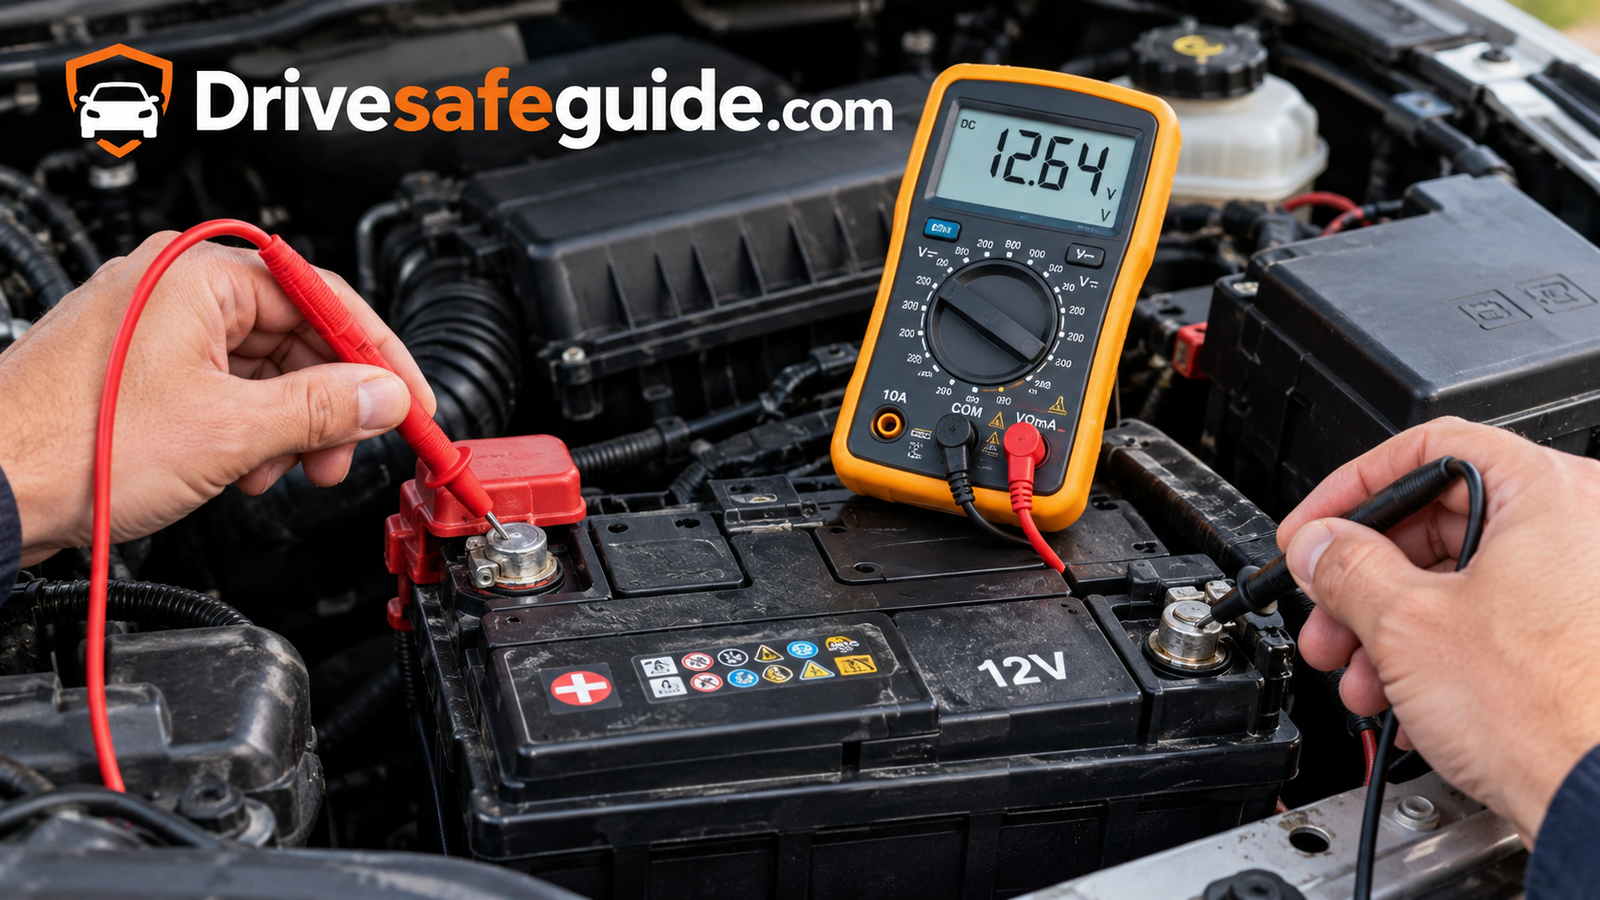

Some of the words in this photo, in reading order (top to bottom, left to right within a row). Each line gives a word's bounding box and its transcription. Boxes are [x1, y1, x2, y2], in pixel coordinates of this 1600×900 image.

[960, 119, 976, 130] DC
[990, 128, 1110, 197] 12.64
[1106, 187, 1117, 200] V
[1101, 208, 1111, 222] V
[1069, 305, 1085, 316] 200
[898, 328, 915, 338] 200
[1066, 331, 1085, 343] 200
[883, 389, 907, 404] 10A
[951, 402, 984, 418] COM
[977, 651, 1067, 688] 12V
